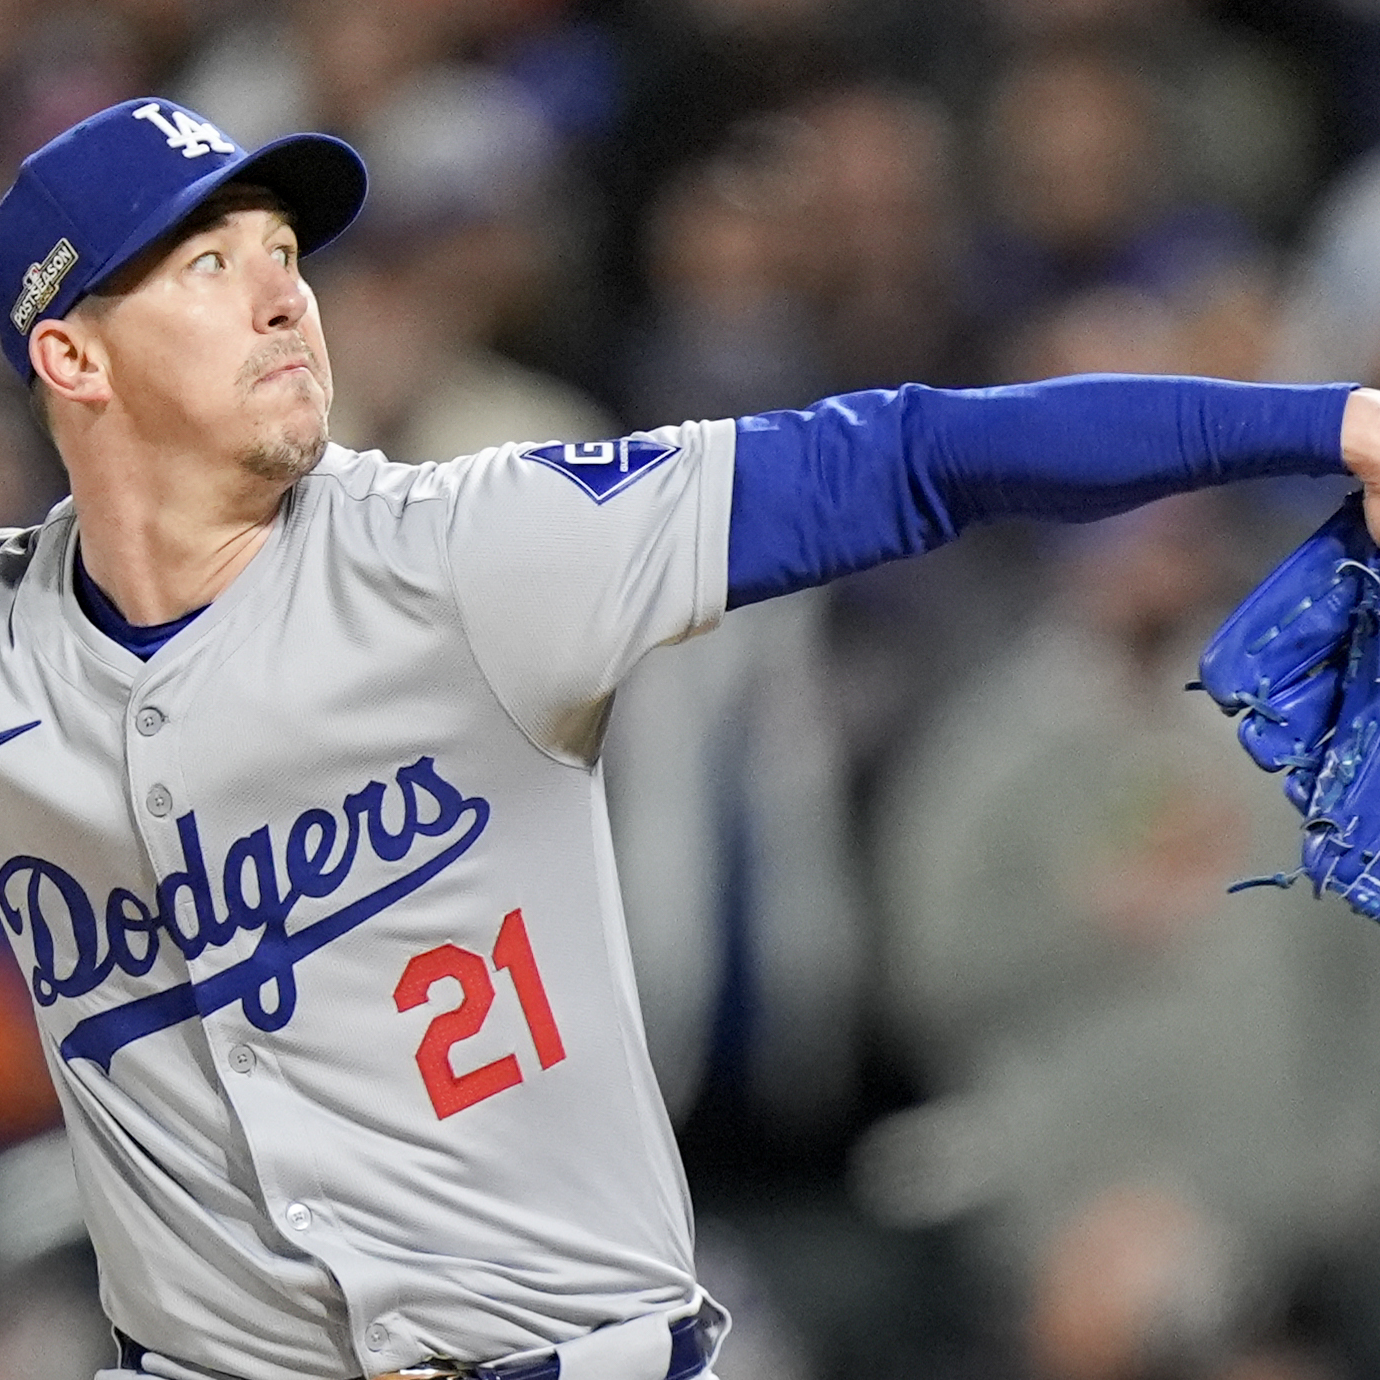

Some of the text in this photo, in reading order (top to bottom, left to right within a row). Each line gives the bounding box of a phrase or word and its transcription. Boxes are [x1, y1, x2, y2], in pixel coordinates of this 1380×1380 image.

[131, 103, 235, 159] LA
[14, 246, 72, 328] POSTSEASON
[393, 908, 566, 1121] 21
